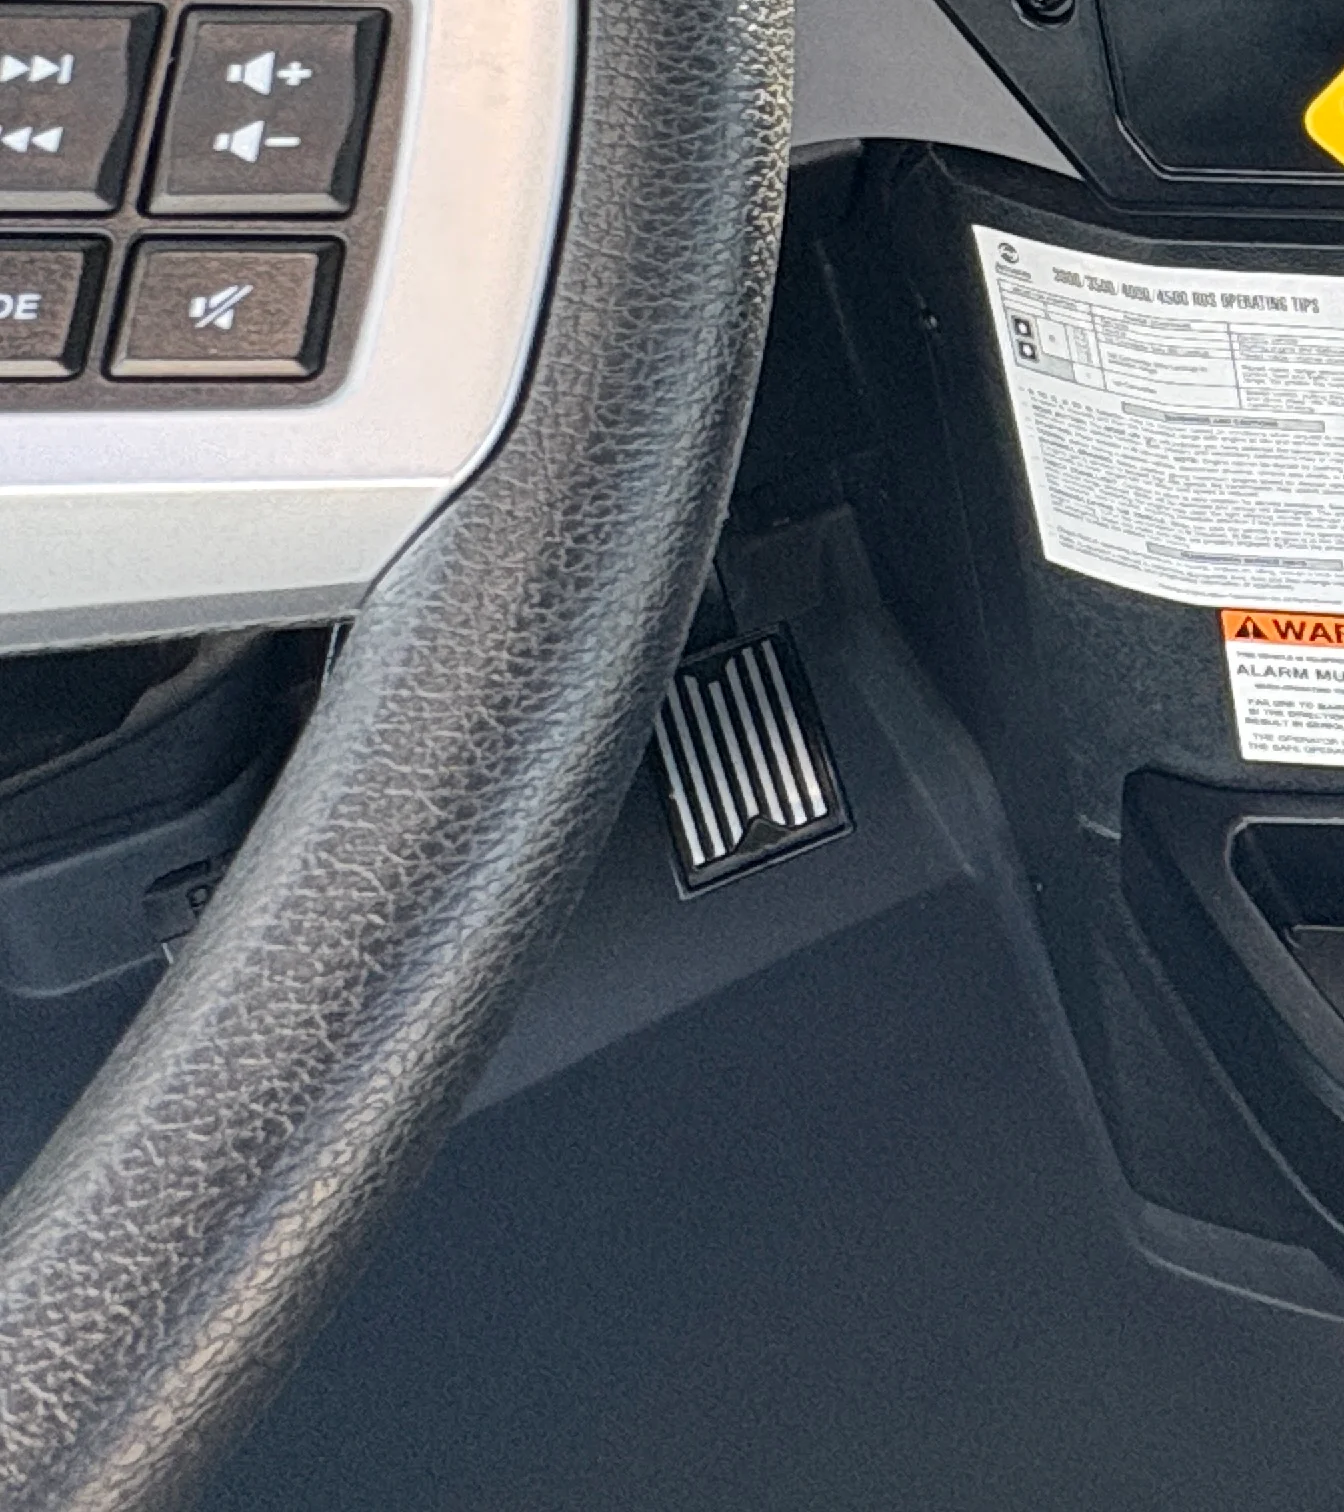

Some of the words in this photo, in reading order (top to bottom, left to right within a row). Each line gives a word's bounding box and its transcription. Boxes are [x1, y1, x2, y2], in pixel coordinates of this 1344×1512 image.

[1220, 293, 1288, 312] OPERATING
[1291, 296, 1320, 314] TIPS
[1236, 663, 1310, 680] ALARM
